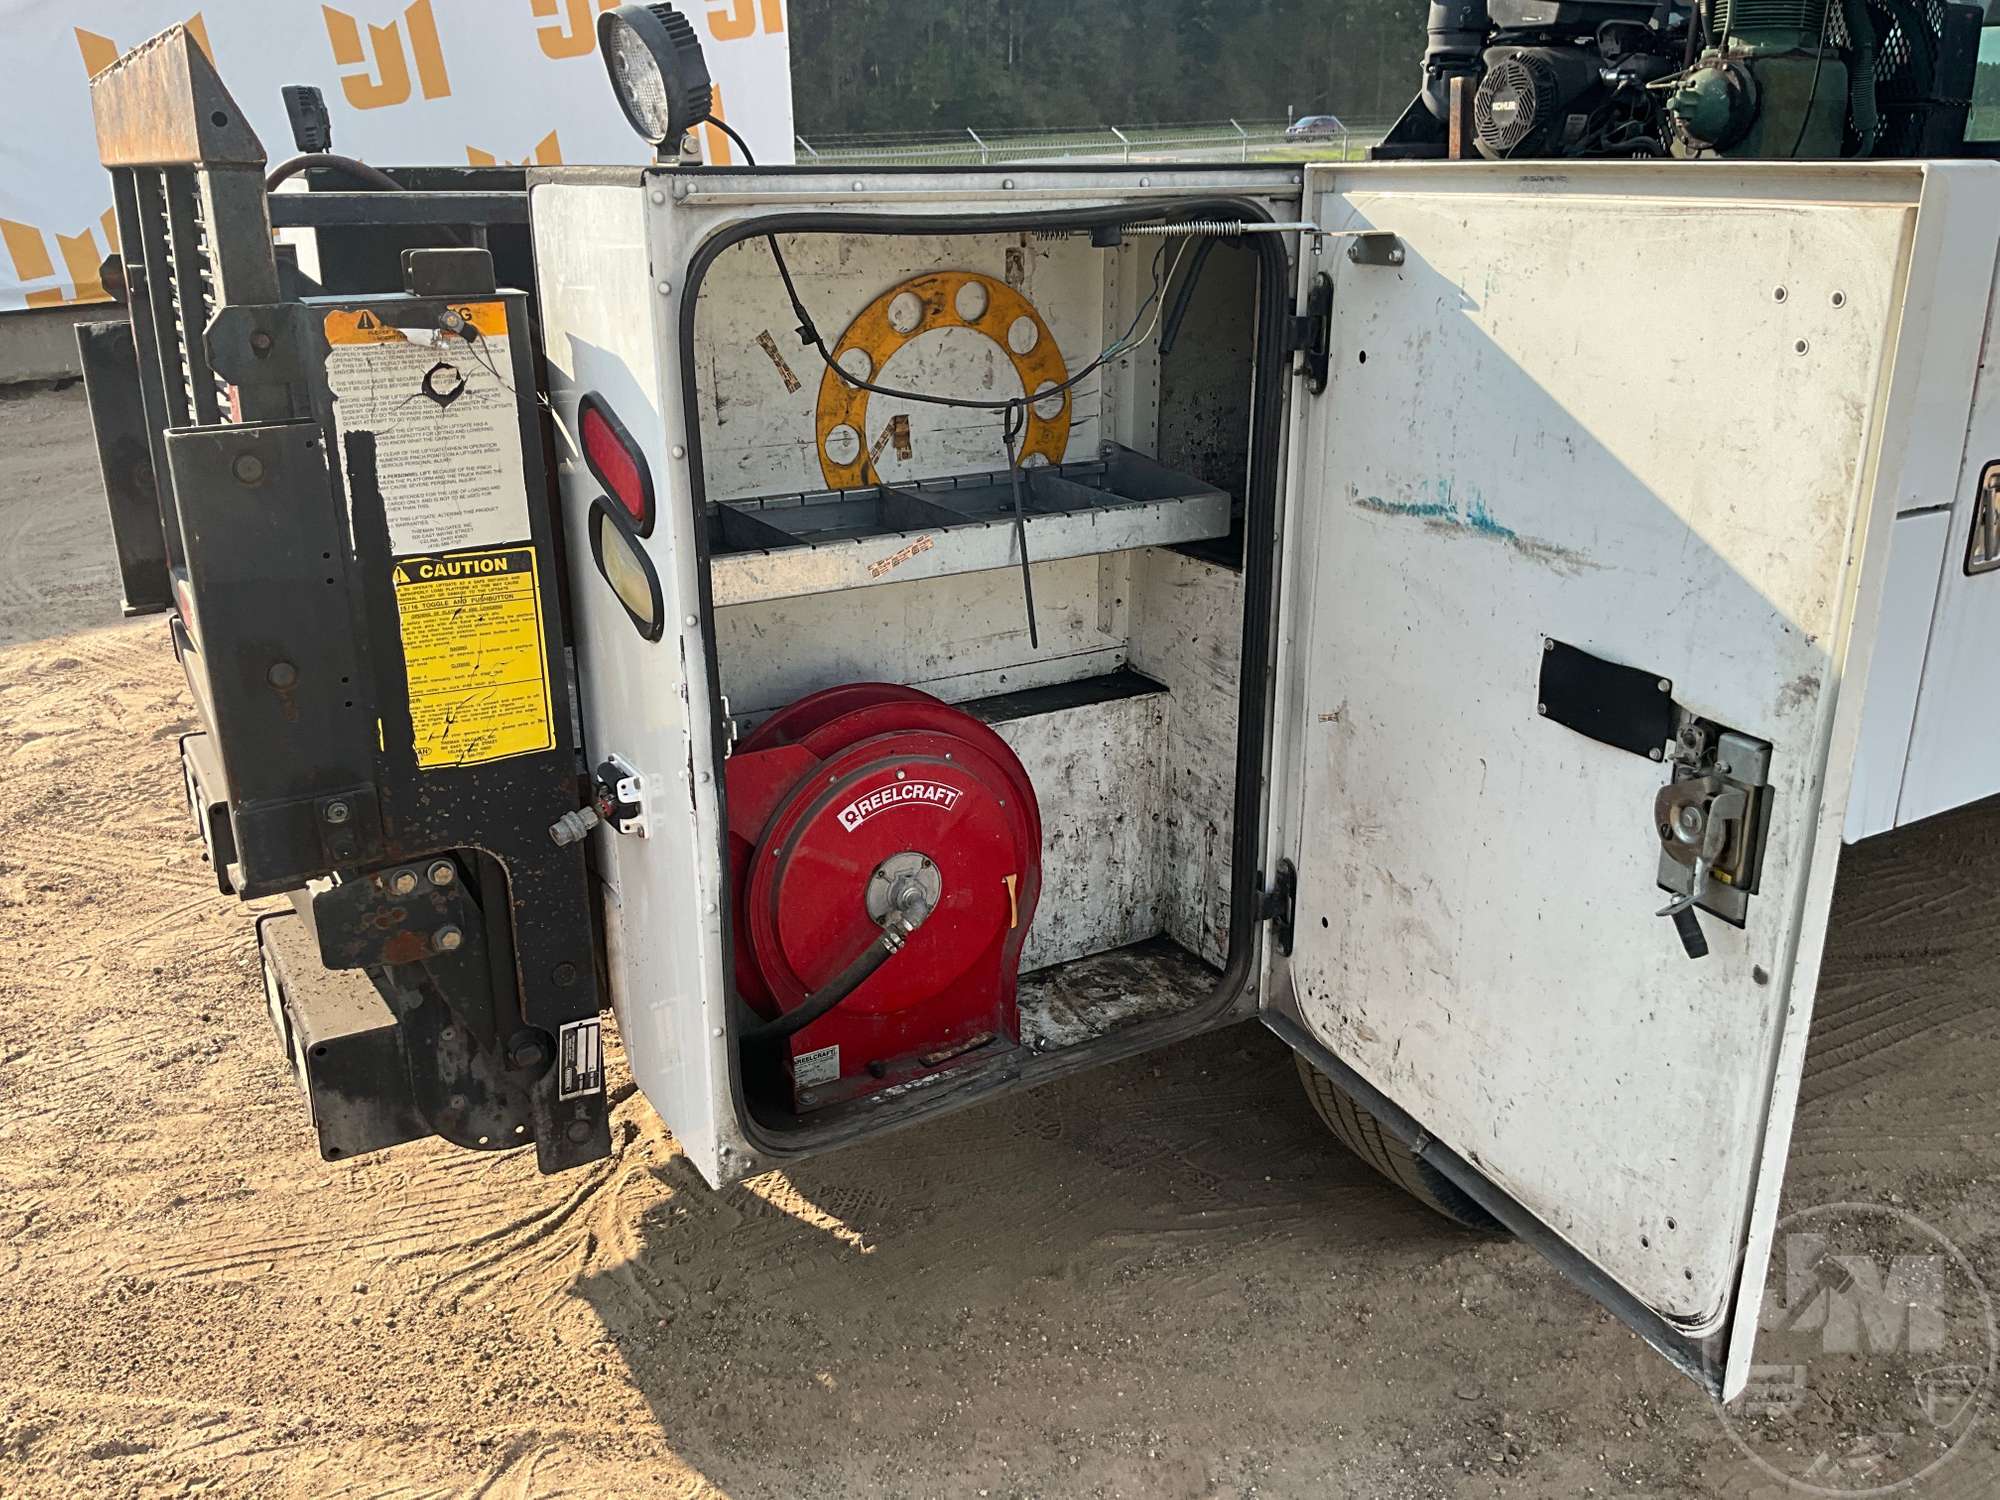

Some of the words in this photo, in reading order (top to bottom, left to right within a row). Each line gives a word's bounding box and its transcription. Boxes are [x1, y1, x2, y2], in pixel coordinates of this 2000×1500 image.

[418, 557, 507, 579] CAUTION
[422, 600, 448, 609] TOGGLE
[470, 592, 514, 603] PUSHBUTTON
[860, 784, 957, 816] REELCRAFT
